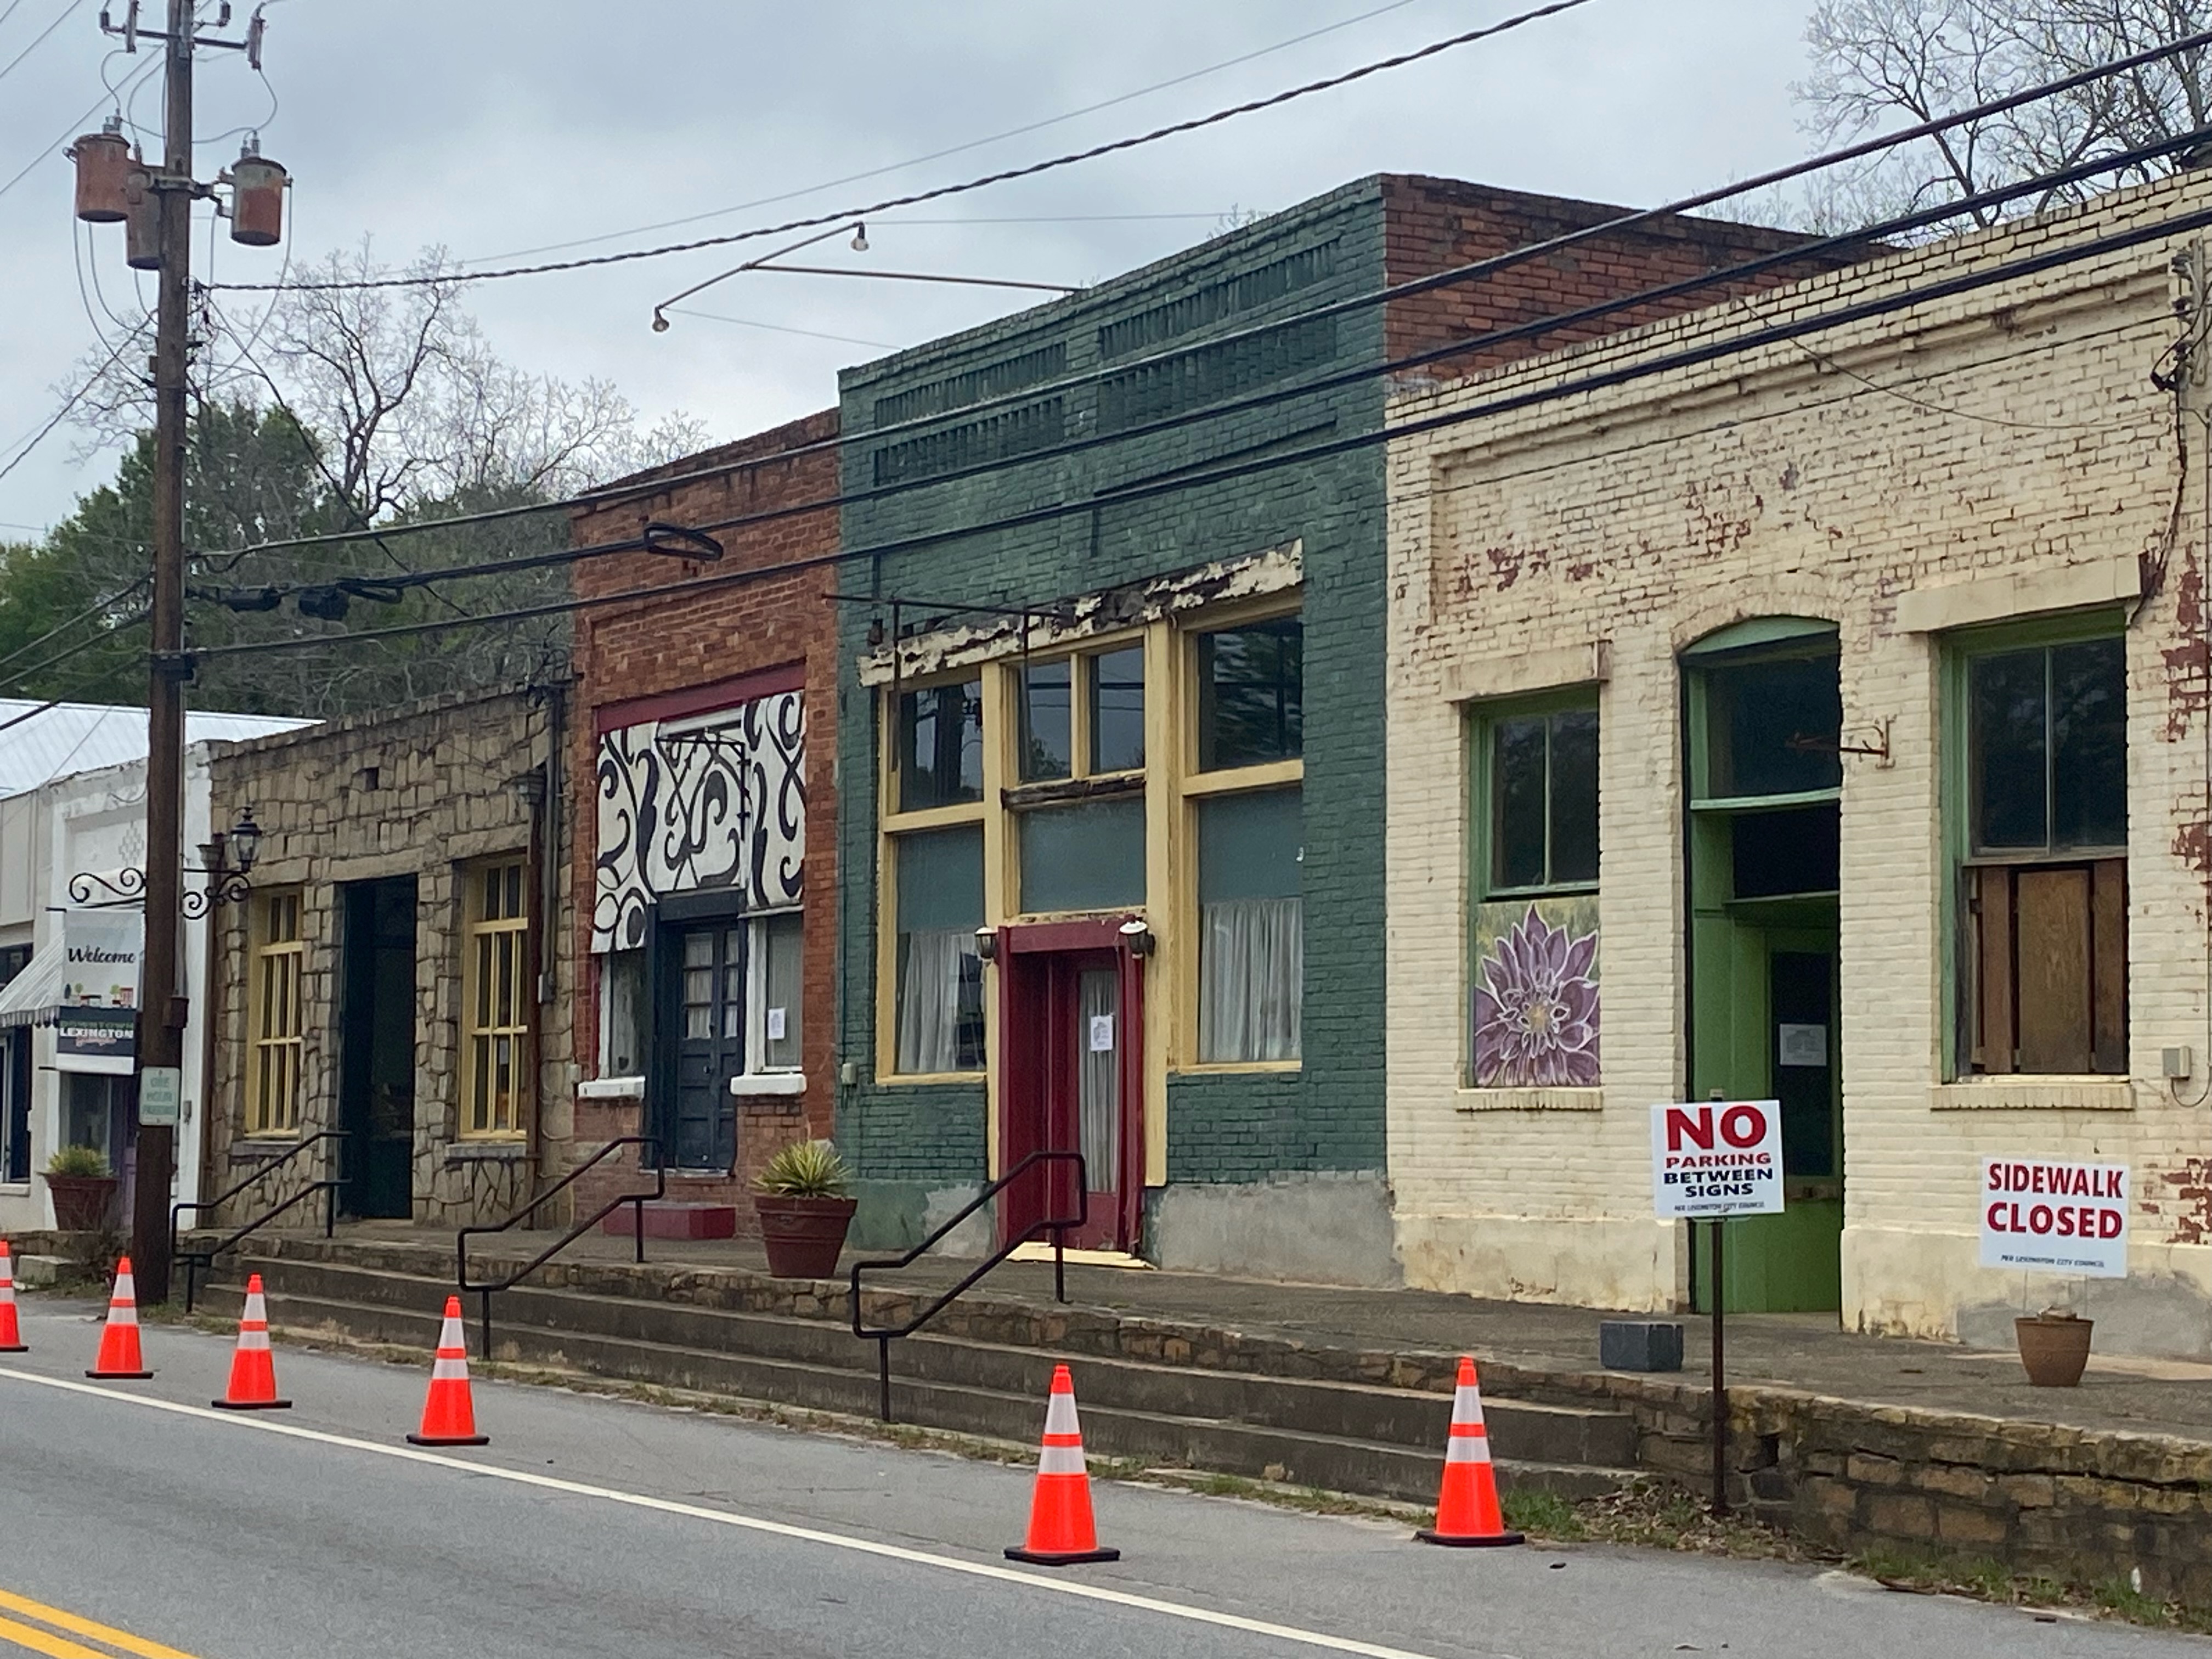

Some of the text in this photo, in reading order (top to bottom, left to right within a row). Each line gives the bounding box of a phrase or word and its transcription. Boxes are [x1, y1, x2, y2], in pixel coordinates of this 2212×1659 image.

[67, 945, 137, 963] Welcome
[59, 1028, 134, 1039] LEXINGTON
[1666, 1105, 1767, 1151] NO
[1666, 1153, 1771, 1169] PARKING
[1664, 1168, 1773, 1184] BETWEEN
[1988, 1163, 2124, 1199] SIDEWALK
[1685, 1183, 1753, 1198] SIGNS
[1987, 1202, 2123, 1239] CLOSED
